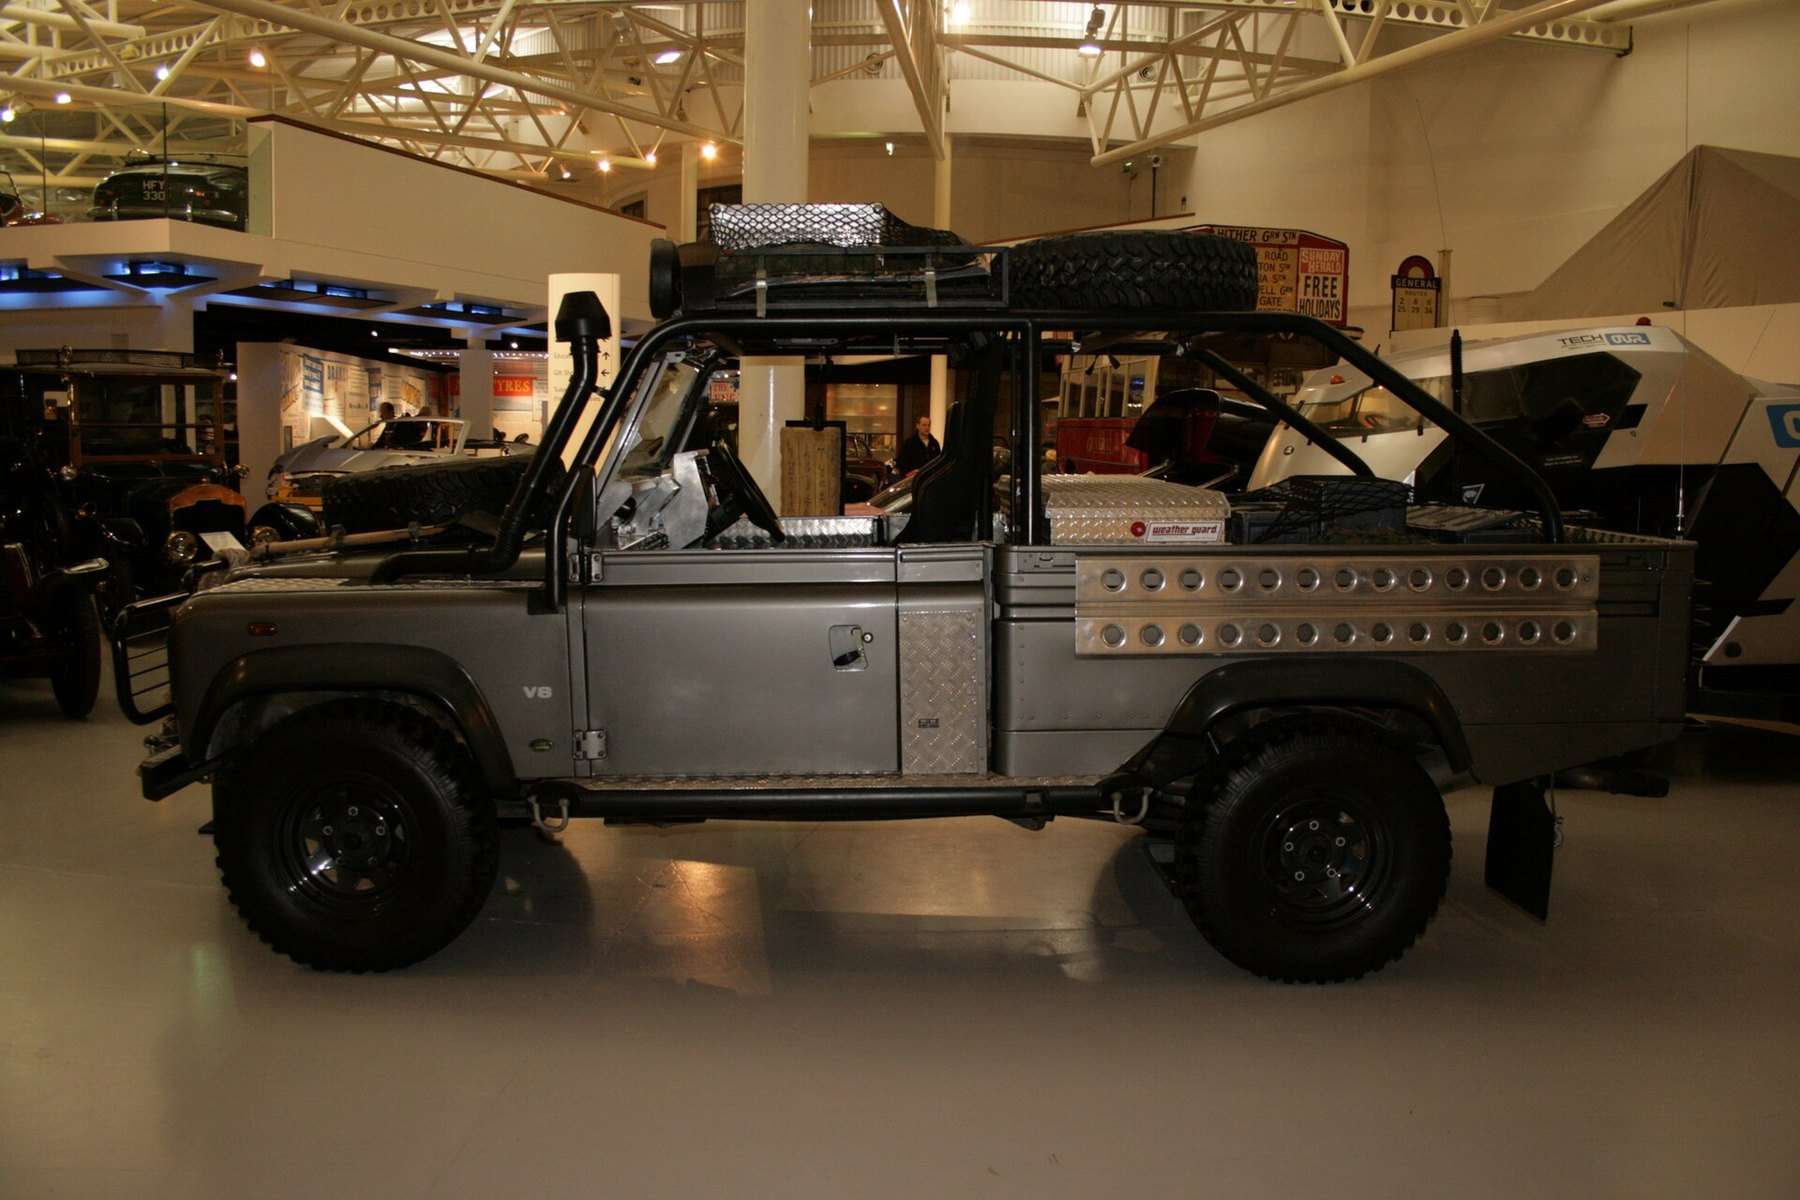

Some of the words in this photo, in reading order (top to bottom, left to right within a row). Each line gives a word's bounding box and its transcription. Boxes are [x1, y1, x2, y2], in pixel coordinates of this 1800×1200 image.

[143, 180, 166, 190] HFY
[143, 191, 166, 201] 330
[1217, 228, 1257, 241] HITHER
[1264, 250, 1288, 261] ROAD
[1301, 250, 1341, 263] SUNDAY
[1258, 262, 1275, 272] TON
[1308, 262, 1341, 273] HERALD
[1304, 276, 1338, 298] FREE
[1396, 278, 1439, 288] GENERAL
[1260, 285, 1277, 295] ELL
[1259, 296, 1283, 306] GATE
[1299, 298, 1341, 319] HOLIDAYS
[1557, 333, 1604, 346] TECH
[1152, 525, 1190, 534] weather
[1192, 525, 1217, 536] guard
[523, 686, 553, 699] V8
